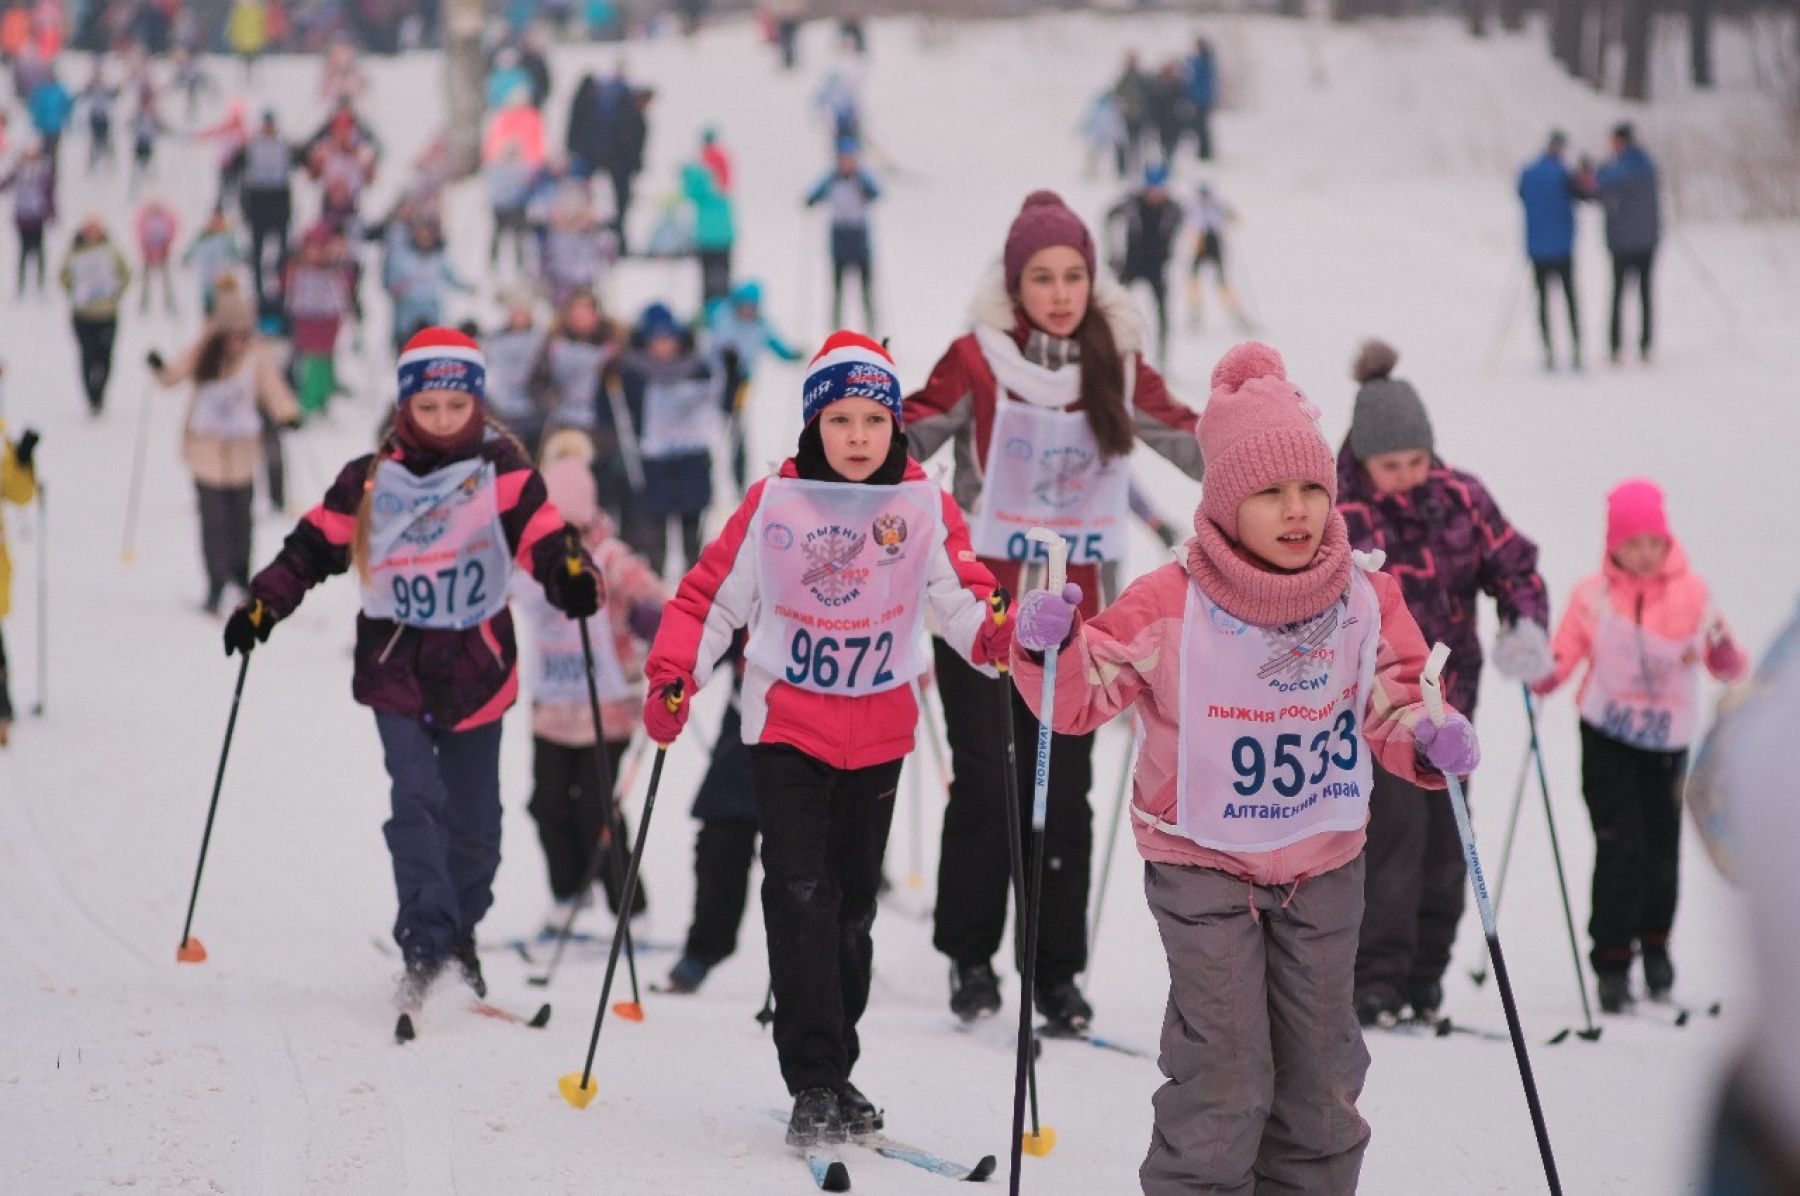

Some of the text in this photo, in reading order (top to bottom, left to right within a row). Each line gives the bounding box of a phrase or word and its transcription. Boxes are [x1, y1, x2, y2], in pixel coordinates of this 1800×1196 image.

[392, 560, 487, 619] 9972
[809, 587, 861, 607] РОССИИ
[817, 617, 871, 631] РОССИИ
[785, 627, 895, 688] 9672
[1268, 673, 1329, 693] РОССИИ
[1207, 704, 1276, 723] ЛЫЖНЯ
[1037, 724, 1048, 787] NORDWAY
[1231, 709, 1358, 798] 9533
[1223, 781, 1361, 819] Алтайский край
